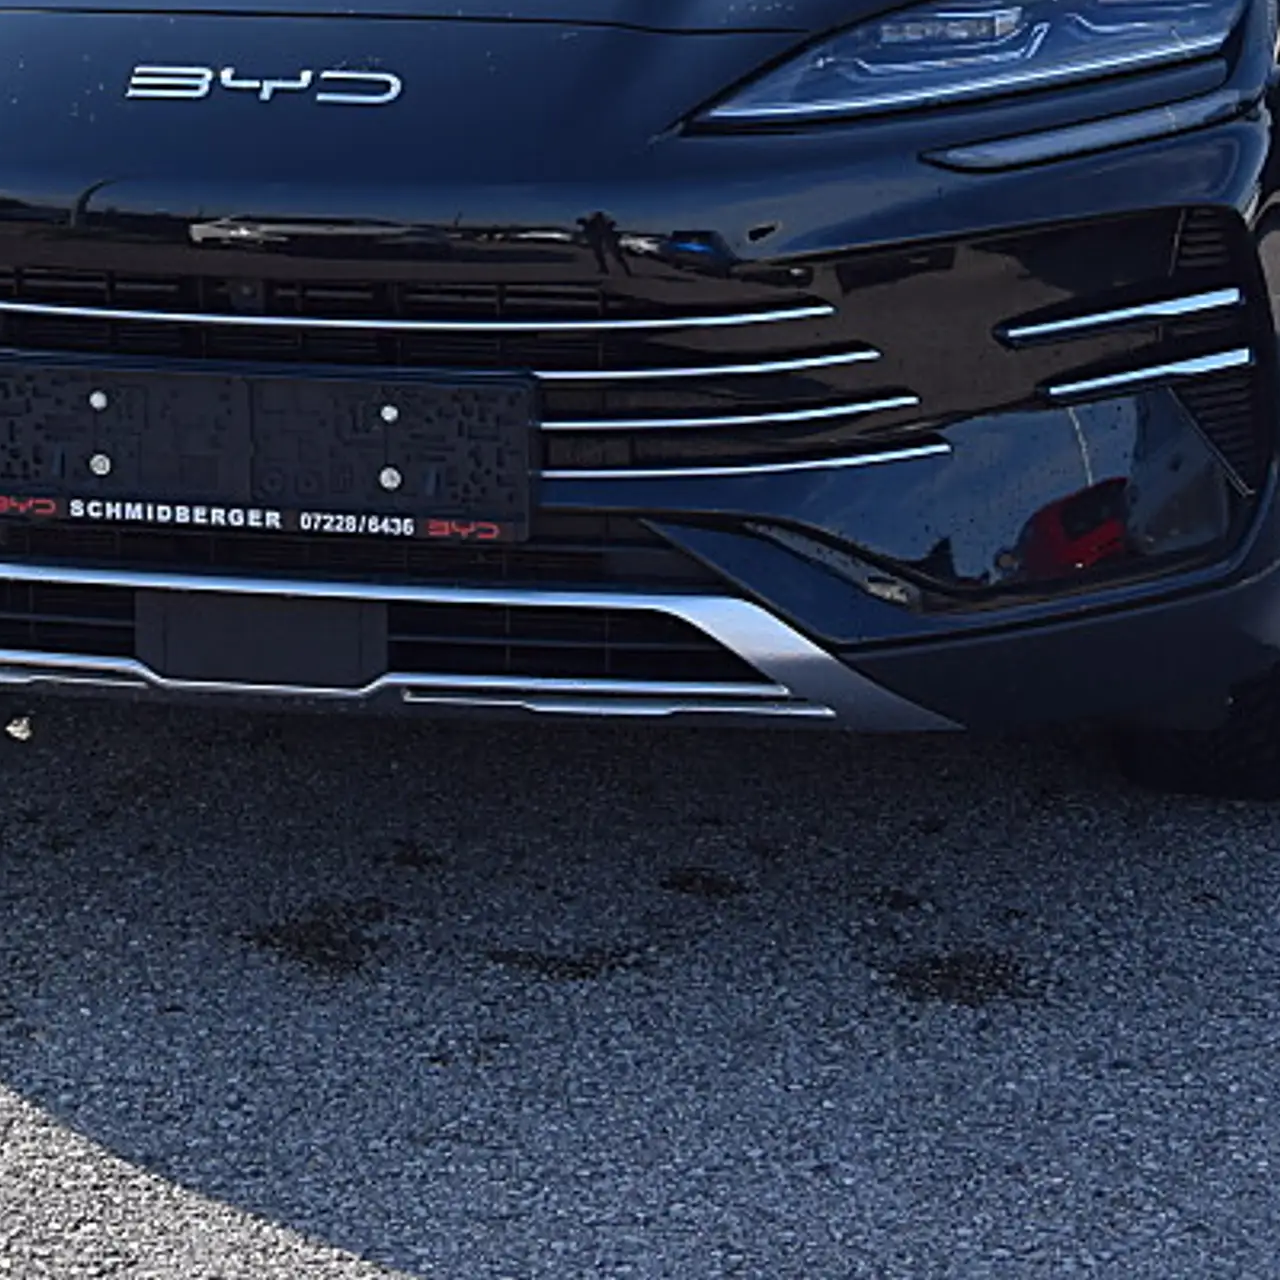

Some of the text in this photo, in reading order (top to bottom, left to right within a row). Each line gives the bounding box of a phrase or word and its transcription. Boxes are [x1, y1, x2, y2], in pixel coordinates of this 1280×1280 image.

[125, 66, 402, 104] BYD
[70, 499, 282, 529] SCHMIDBERGER
[428, 519, 500, 539] BYD
